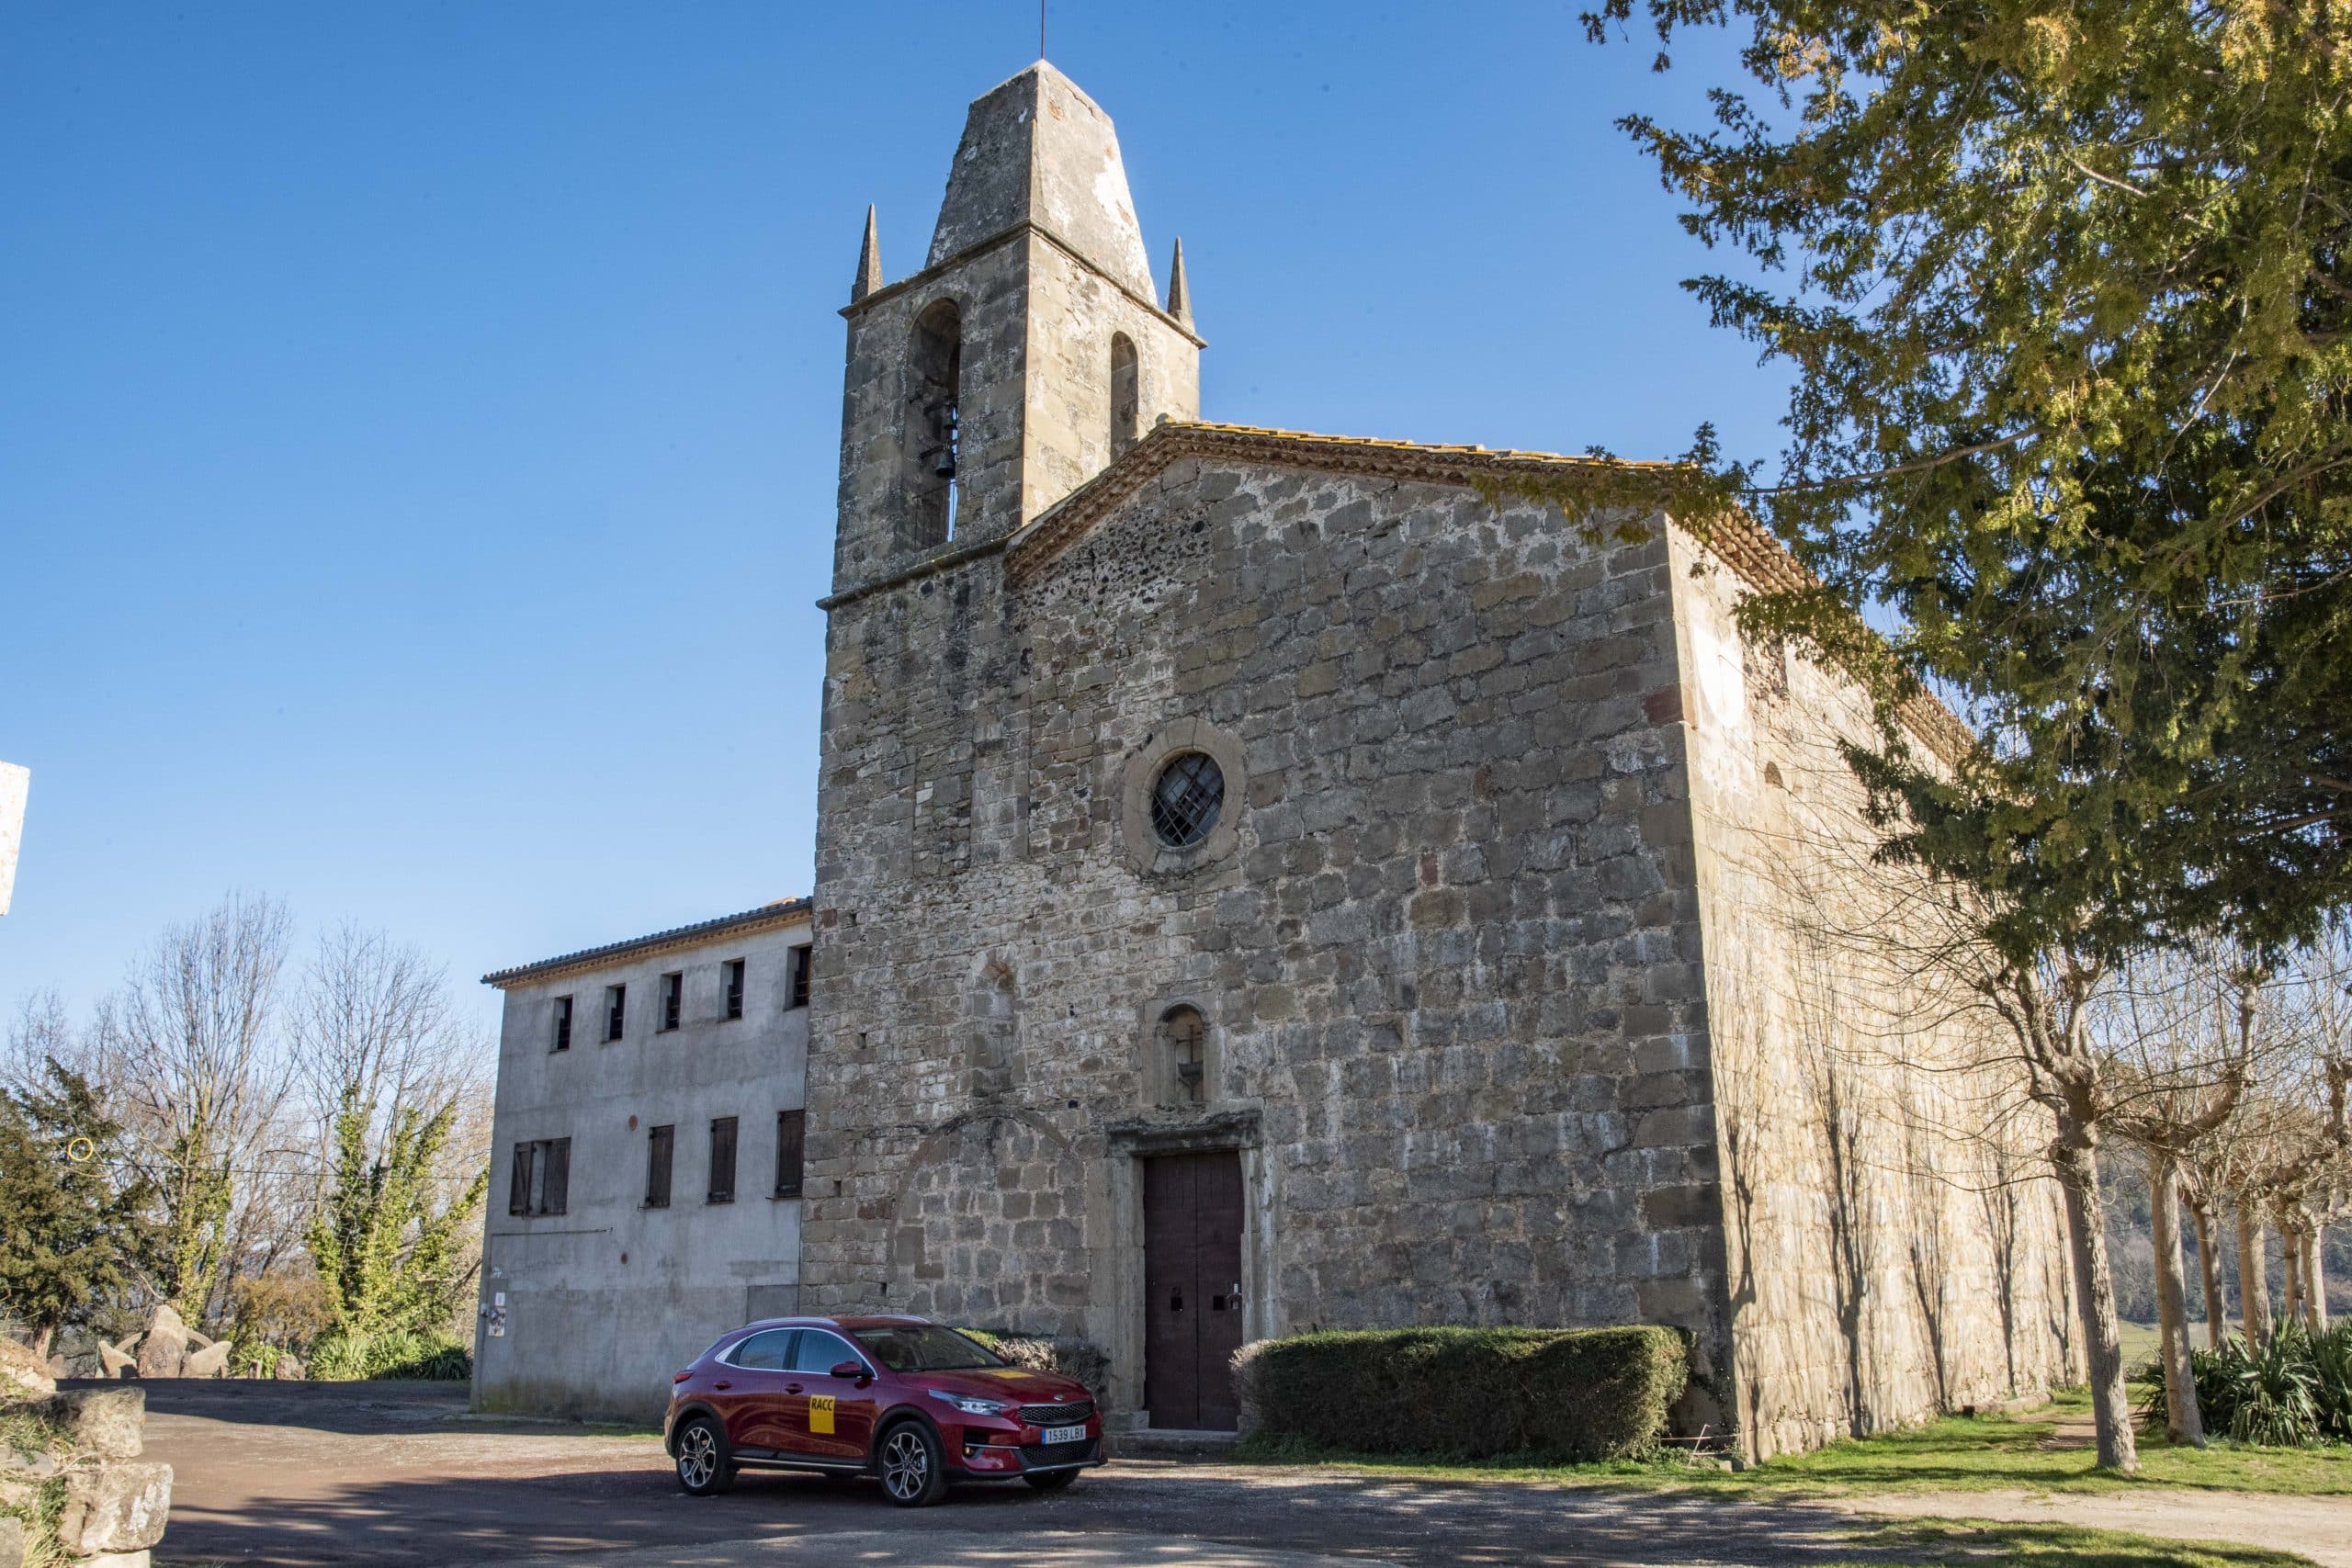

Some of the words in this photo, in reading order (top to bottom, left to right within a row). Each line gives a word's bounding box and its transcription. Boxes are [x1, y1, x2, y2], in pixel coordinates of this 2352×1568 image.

[811, 1398, 833, 1411] RACC
[1049, 1428, 1069, 1441] 1539
[1069, 1427, 1084, 1439] LBX
